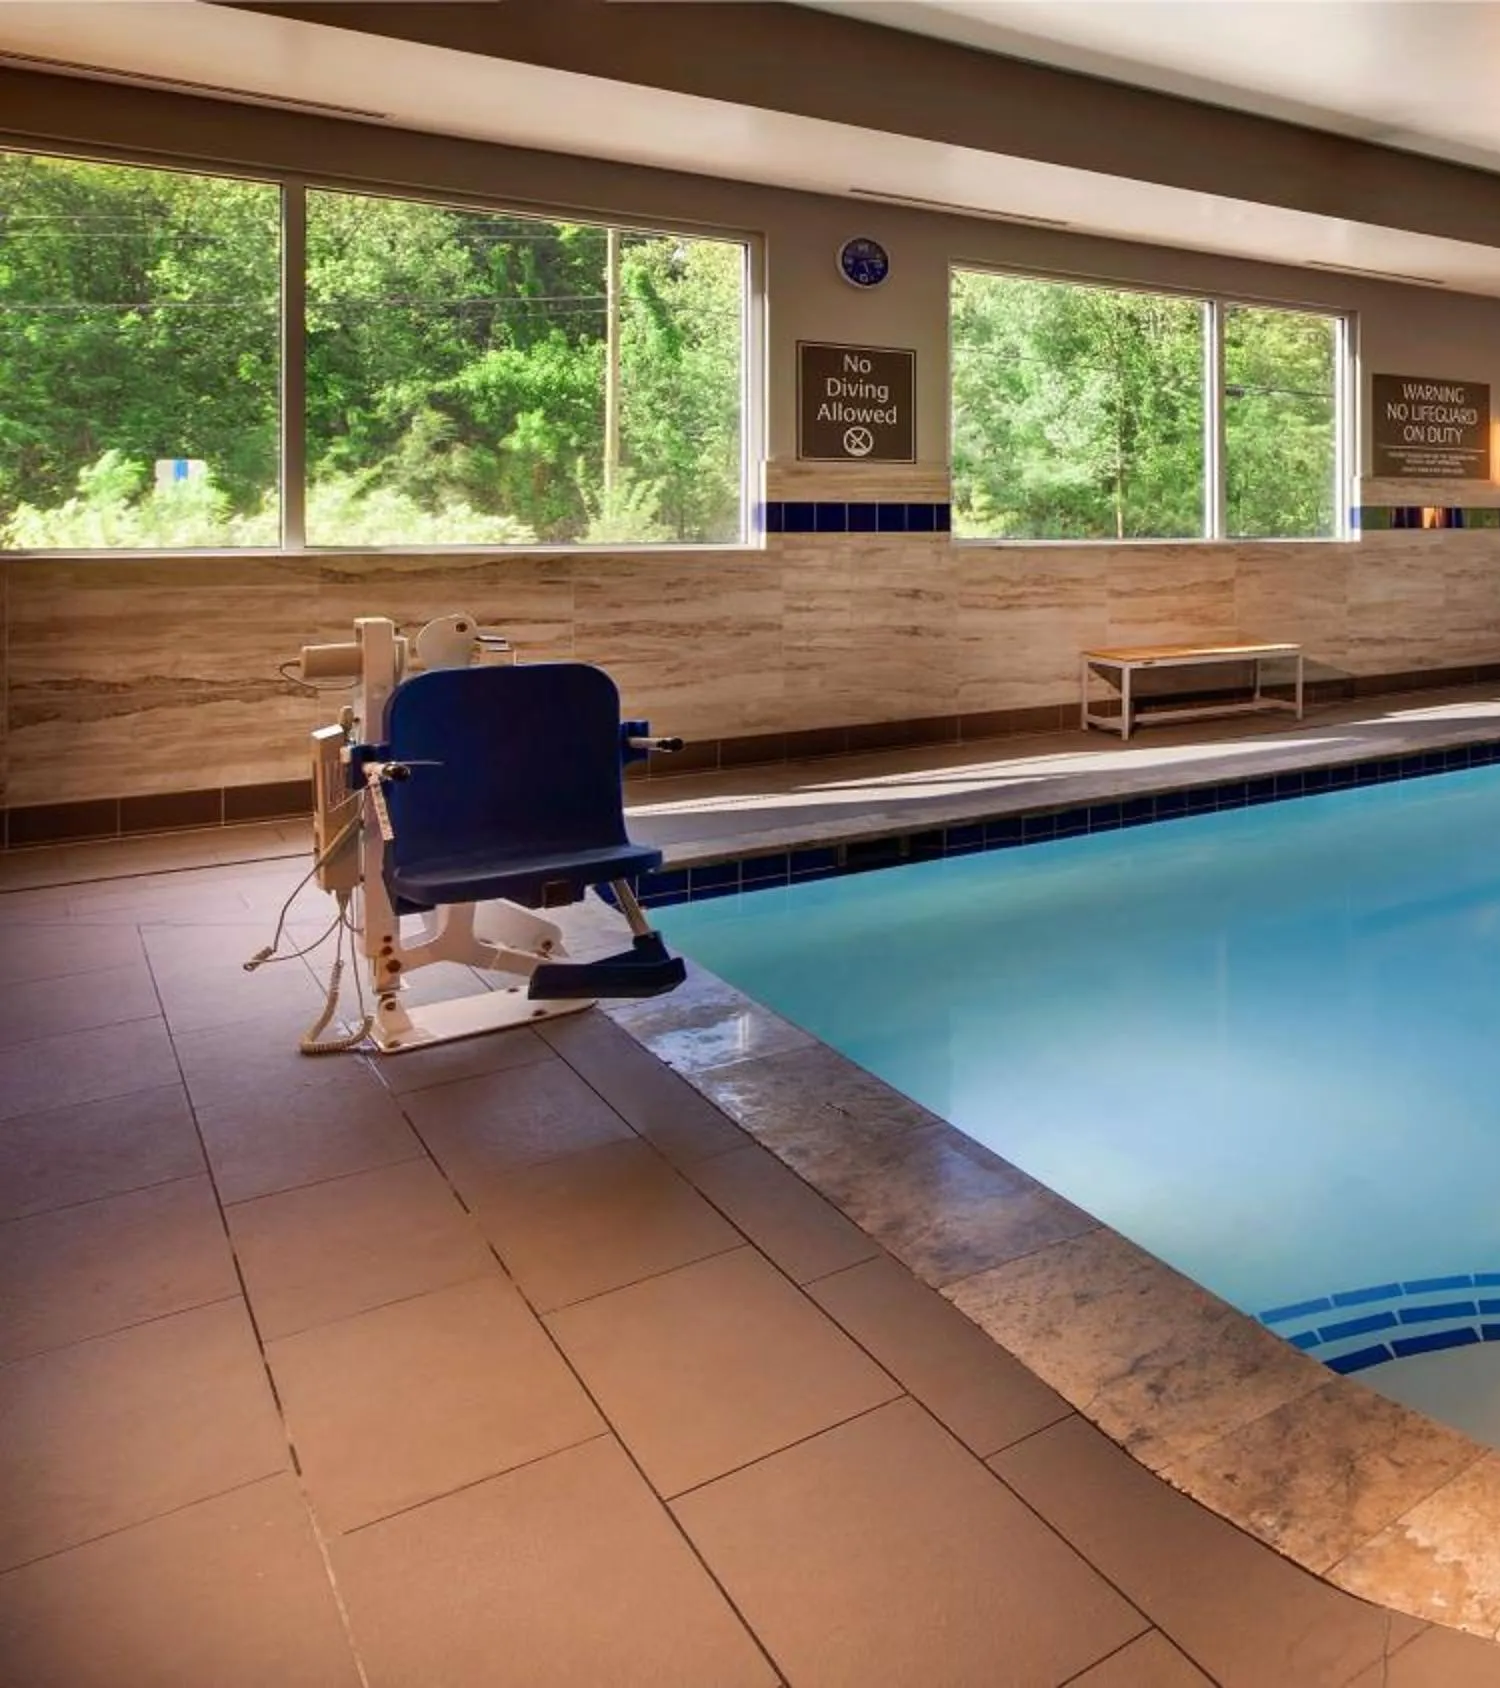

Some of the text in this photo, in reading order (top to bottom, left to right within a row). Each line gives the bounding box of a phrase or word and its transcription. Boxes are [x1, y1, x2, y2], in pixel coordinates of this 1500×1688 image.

[843, 354, 871, 374] No
[827, 377, 889, 402] Diving
[1401, 383, 1464, 404] WARNING
[816, 402, 897, 425] Allowed
[1387, 402, 1478, 425] NO LIFEGUARD
[1403, 424, 1463, 444] ON DUTY
